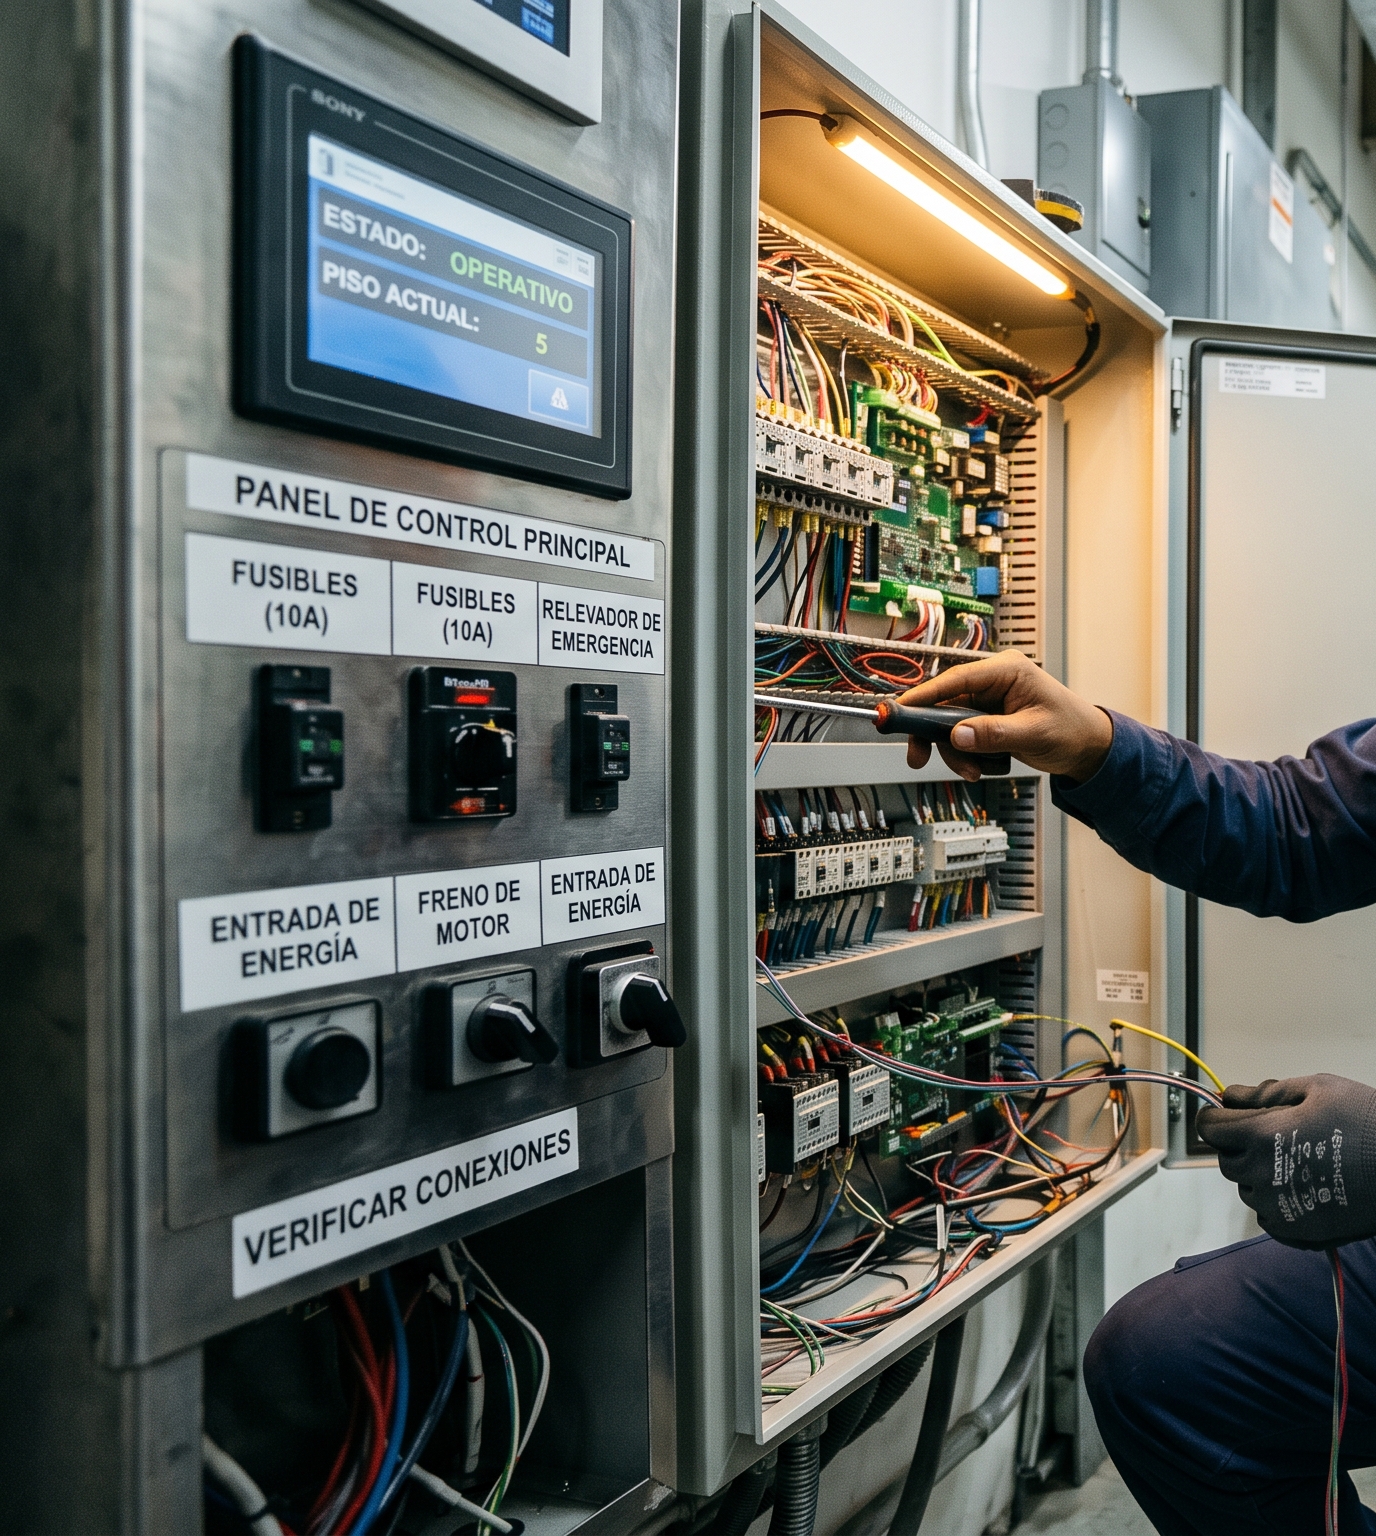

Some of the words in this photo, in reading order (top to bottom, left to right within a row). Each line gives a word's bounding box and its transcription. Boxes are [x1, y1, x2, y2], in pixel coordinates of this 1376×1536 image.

[312, 89, 366, 122] SONY
[324, 202, 425, 260] ESTADO:
[449, 250, 573, 314] OPERATIVO
[323, 261, 380, 299] PISO
[385, 284, 480, 332] ACTUAL:
[535, 332, 547, 354] 5
[236, 475, 340, 521] PANEL
[351, 497, 387, 528] DE
[396, 505, 517, 550] CONTROL
[524, 528, 630, 569] PRINCIPAL
[232, 560, 358, 598] FUSIBLES
[417, 582, 515, 615] FUSIBLES
[265, 602, 328, 635] (10A)
[442, 618, 493, 648] (10A)
[543, 600, 639, 631] RELEVADOR
[642, 613, 661, 633] DE
[551, 631, 654, 659] EMERGENCIA
[551, 866, 630, 895] ENTRADA
[635, 862, 655, 882] DE
[418, 884, 489, 914] FRENO
[495, 880, 520, 903] DE
[568, 889, 641, 923] ENERGÍA
[211, 905, 340, 943] ENTRADA
[348, 897, 380, 925] DE
[437, 913, 510, 945] MOTOR
[241, 933, 358, 978] ENERGÍA
[245, 1184, 407, 1266] VERIFICAR
[416, 1128, 571, 1204] CONEXIONES
